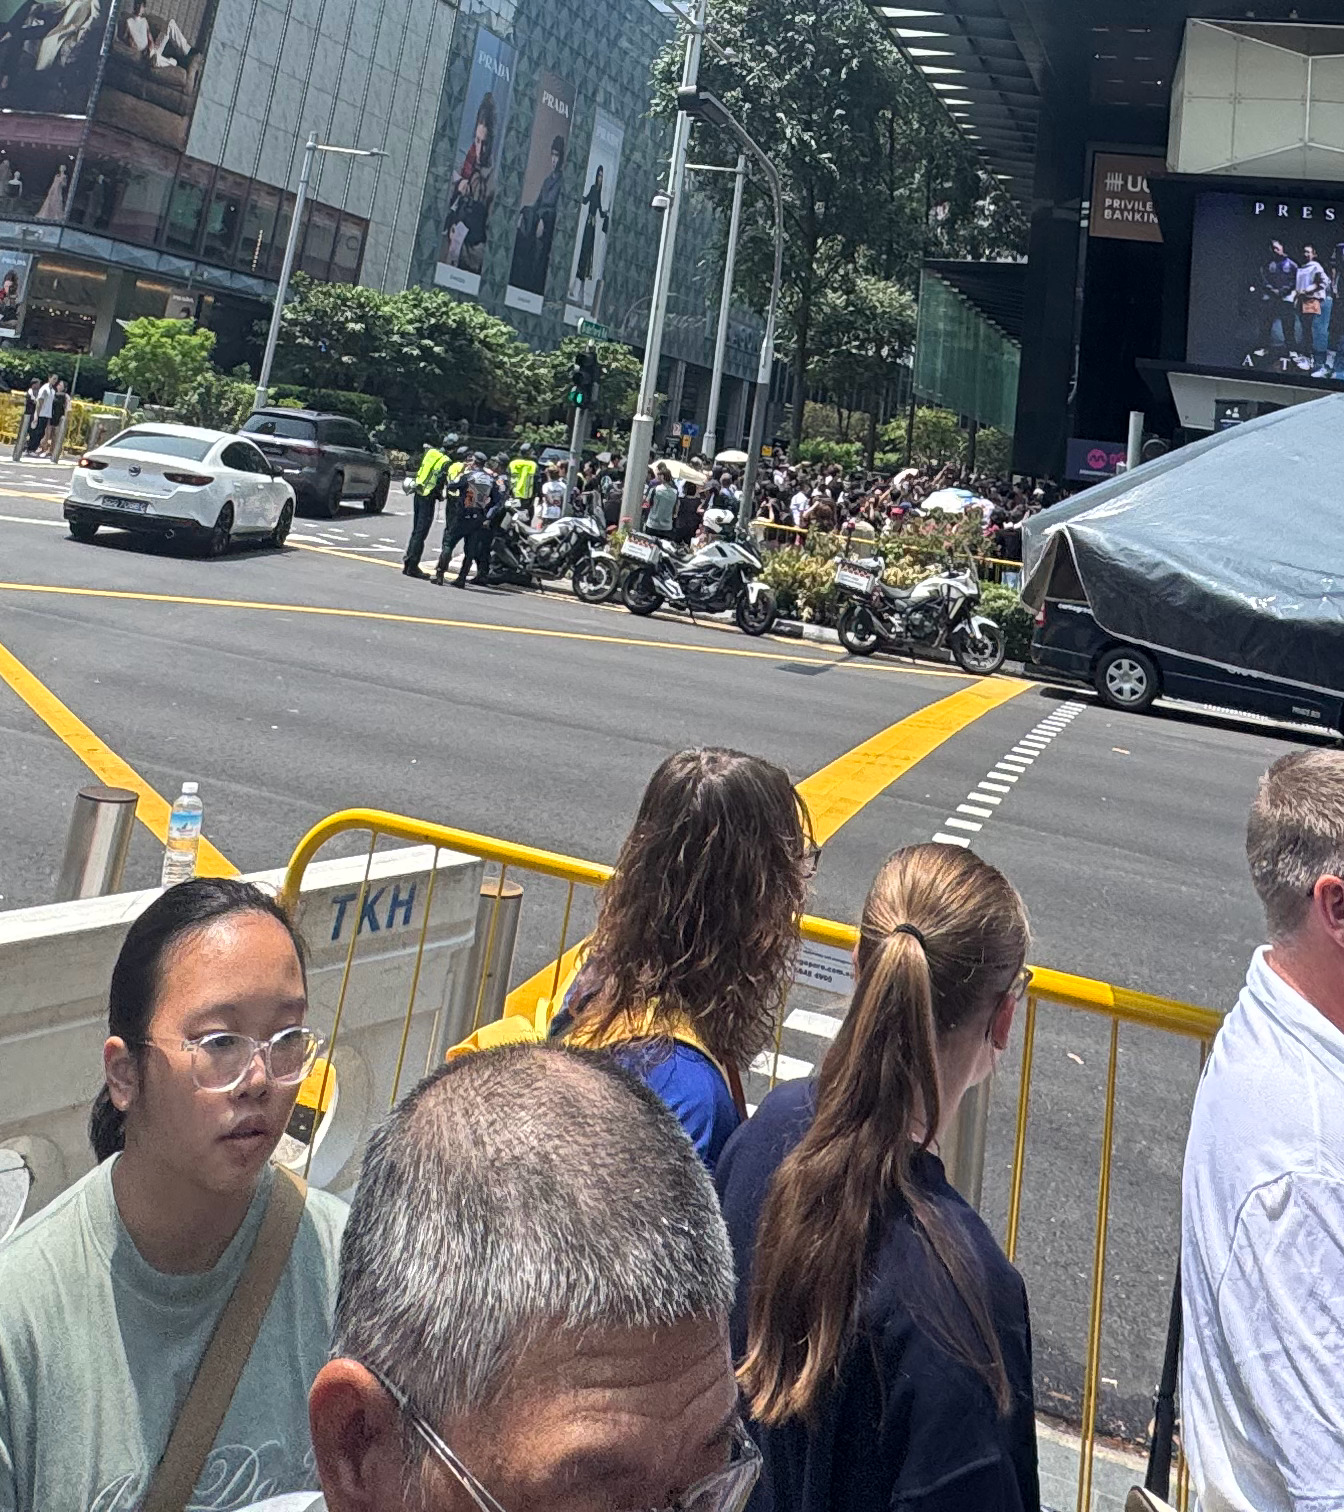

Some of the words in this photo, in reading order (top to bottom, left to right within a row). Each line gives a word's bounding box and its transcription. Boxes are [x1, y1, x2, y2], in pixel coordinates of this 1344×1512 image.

[478, 50, 511, 82] PRADA
[542, 90, 570, 118] PRADA
[331, 882, 417, 941] TKH
